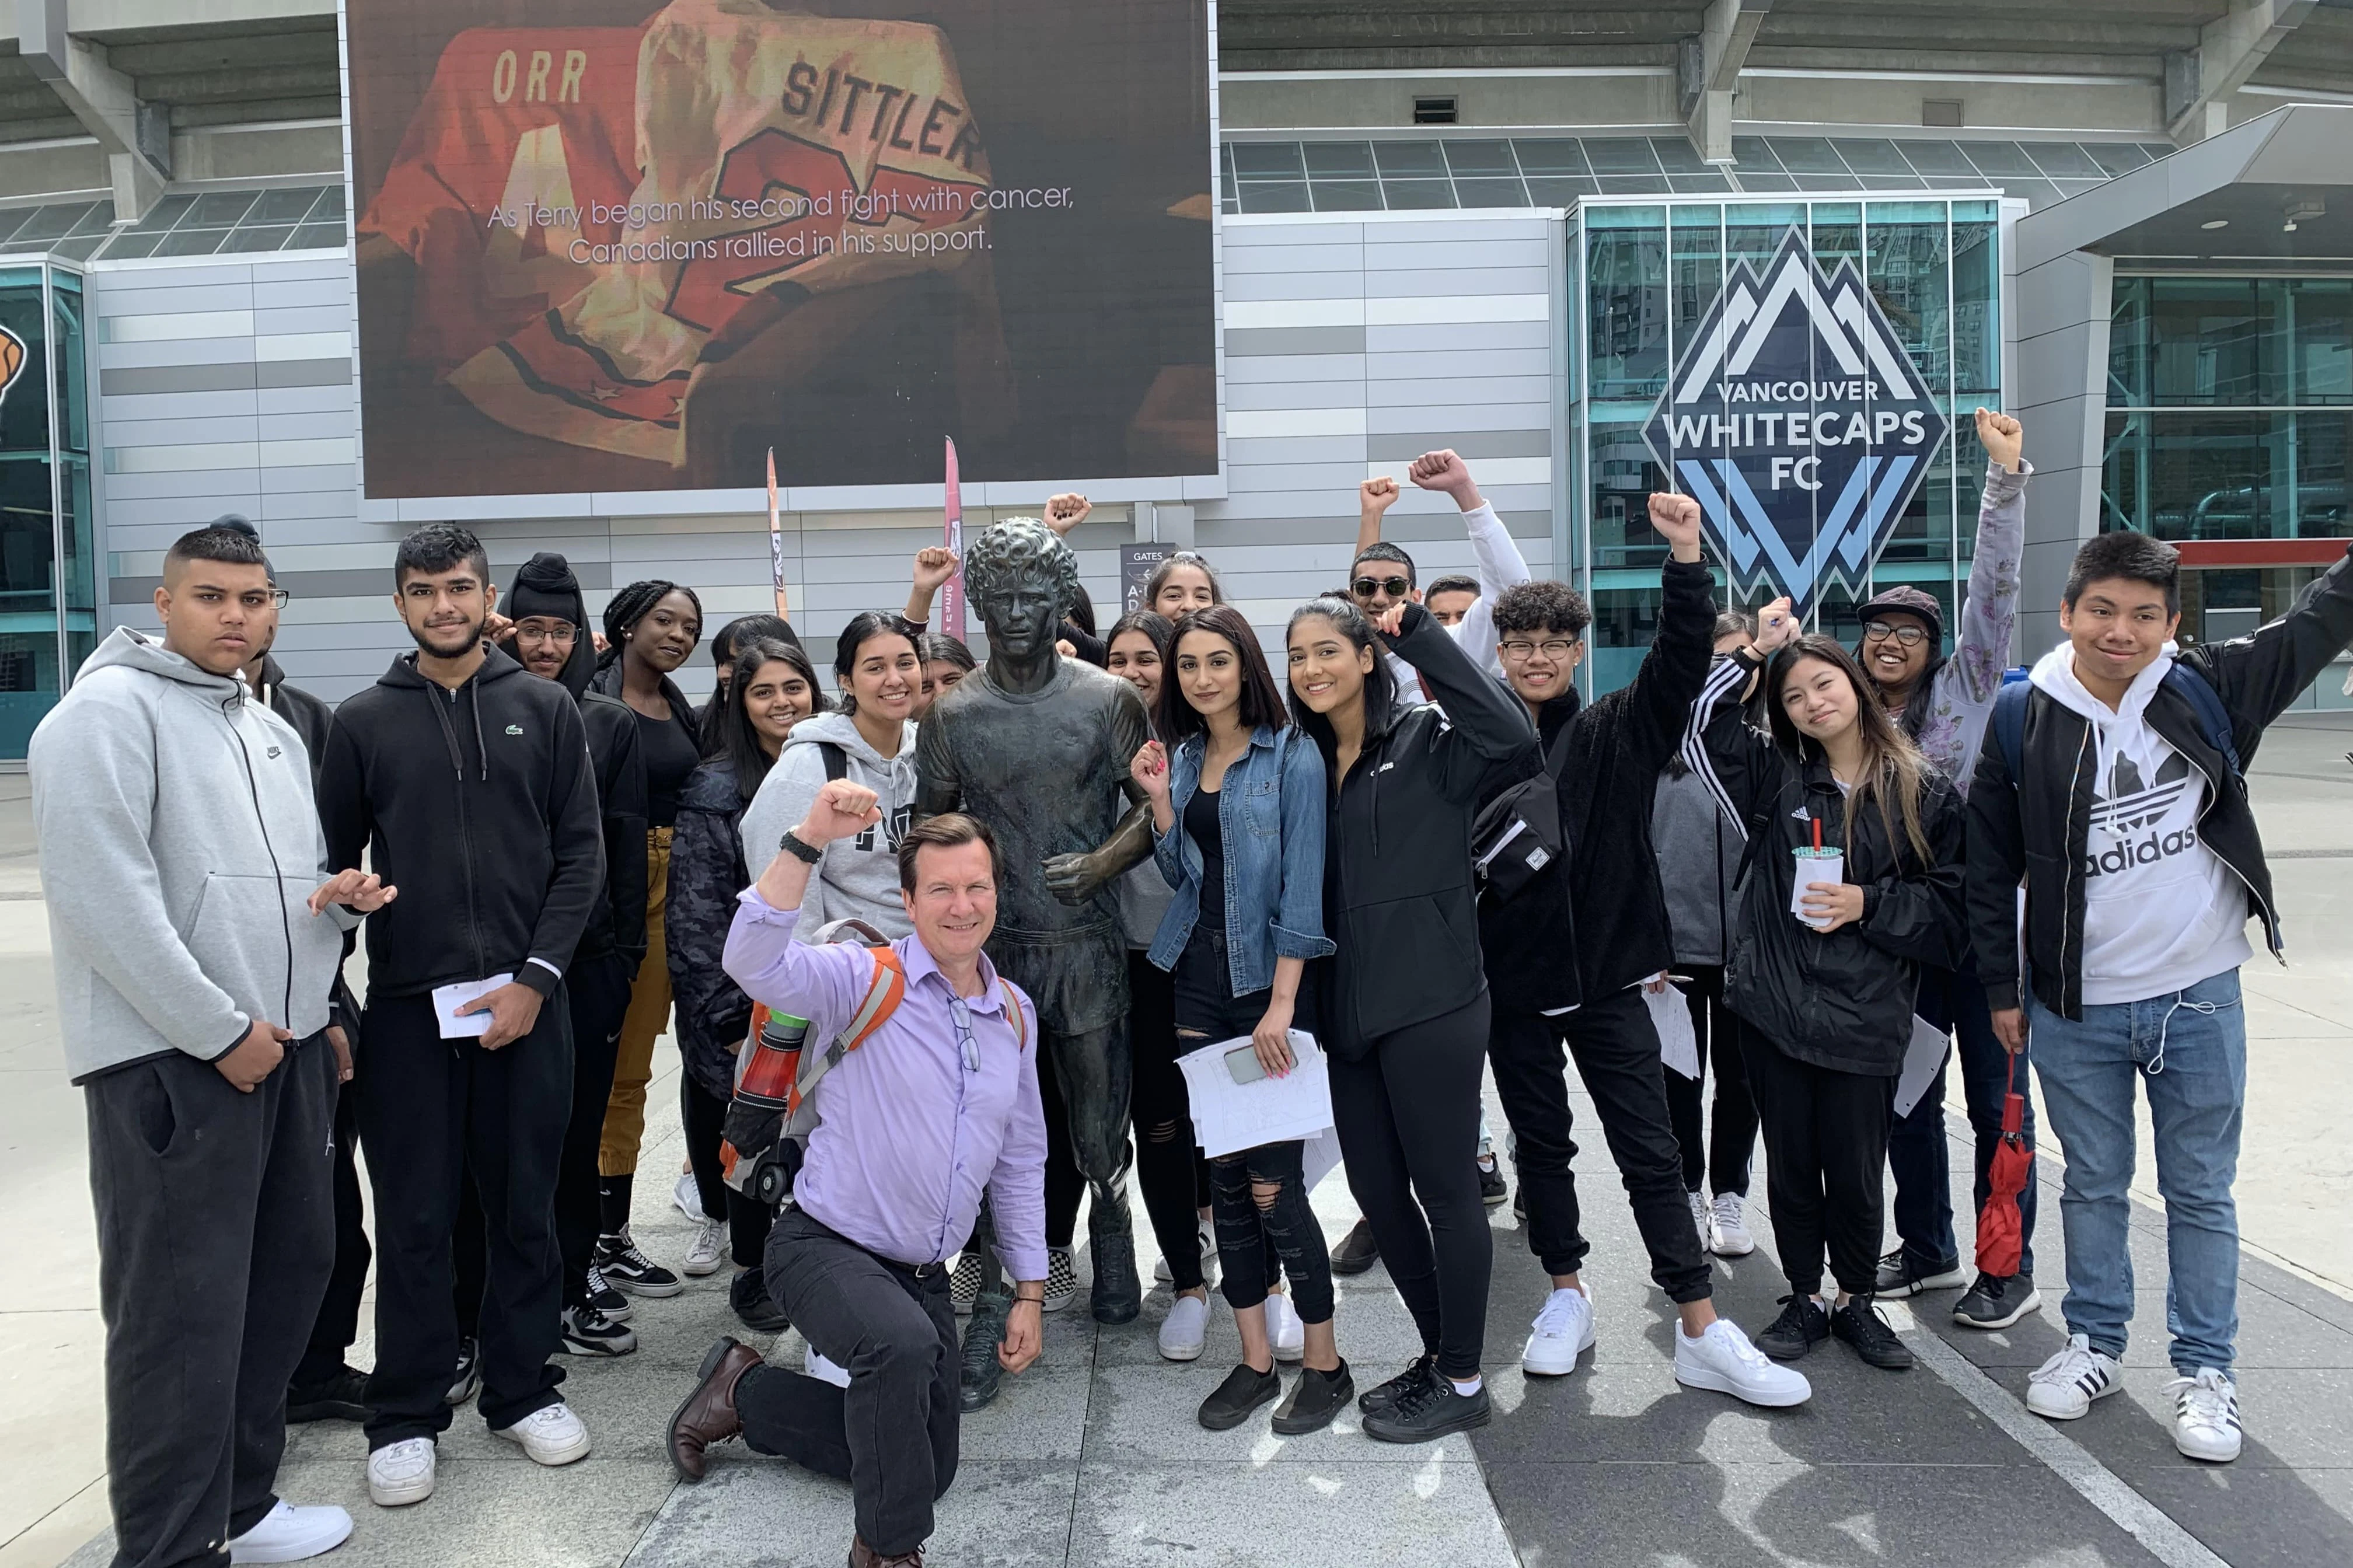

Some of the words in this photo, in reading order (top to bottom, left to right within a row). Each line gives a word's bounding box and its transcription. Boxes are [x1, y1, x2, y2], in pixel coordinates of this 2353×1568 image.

[493, 49, 587, 103] ORR
[782, 60, 983, 169] SITTLER
[487, 204, 518, 228] As
[525, 202, 584, 231] Terry
[591, 199, 682, 229] began
[691, 194, 723, 220] his
[730, 190, 832, 219] second
[840, 186, 899, 221] fight
[906, 186, 962, 212] with
[970, 186, 1074, 210] cancer,
[568, 235, 717, 264] Canadians
[725, 231, 804, 257] rallied
[813, 229, 834, 256] in
[842, 228, 875, 254] his
[882, 225, 993, 257] support.
[1716, 380, 1879, 403] VANCOUVER
[1662, 410, 1925, 449] WHITECAPS
[1771, 456, 1824, 491] FC
[1133, 552, 1162, 561] GATES
[1792, 812, 1811, 822] adidas
[2085, 824, 2196, 878] adidas
